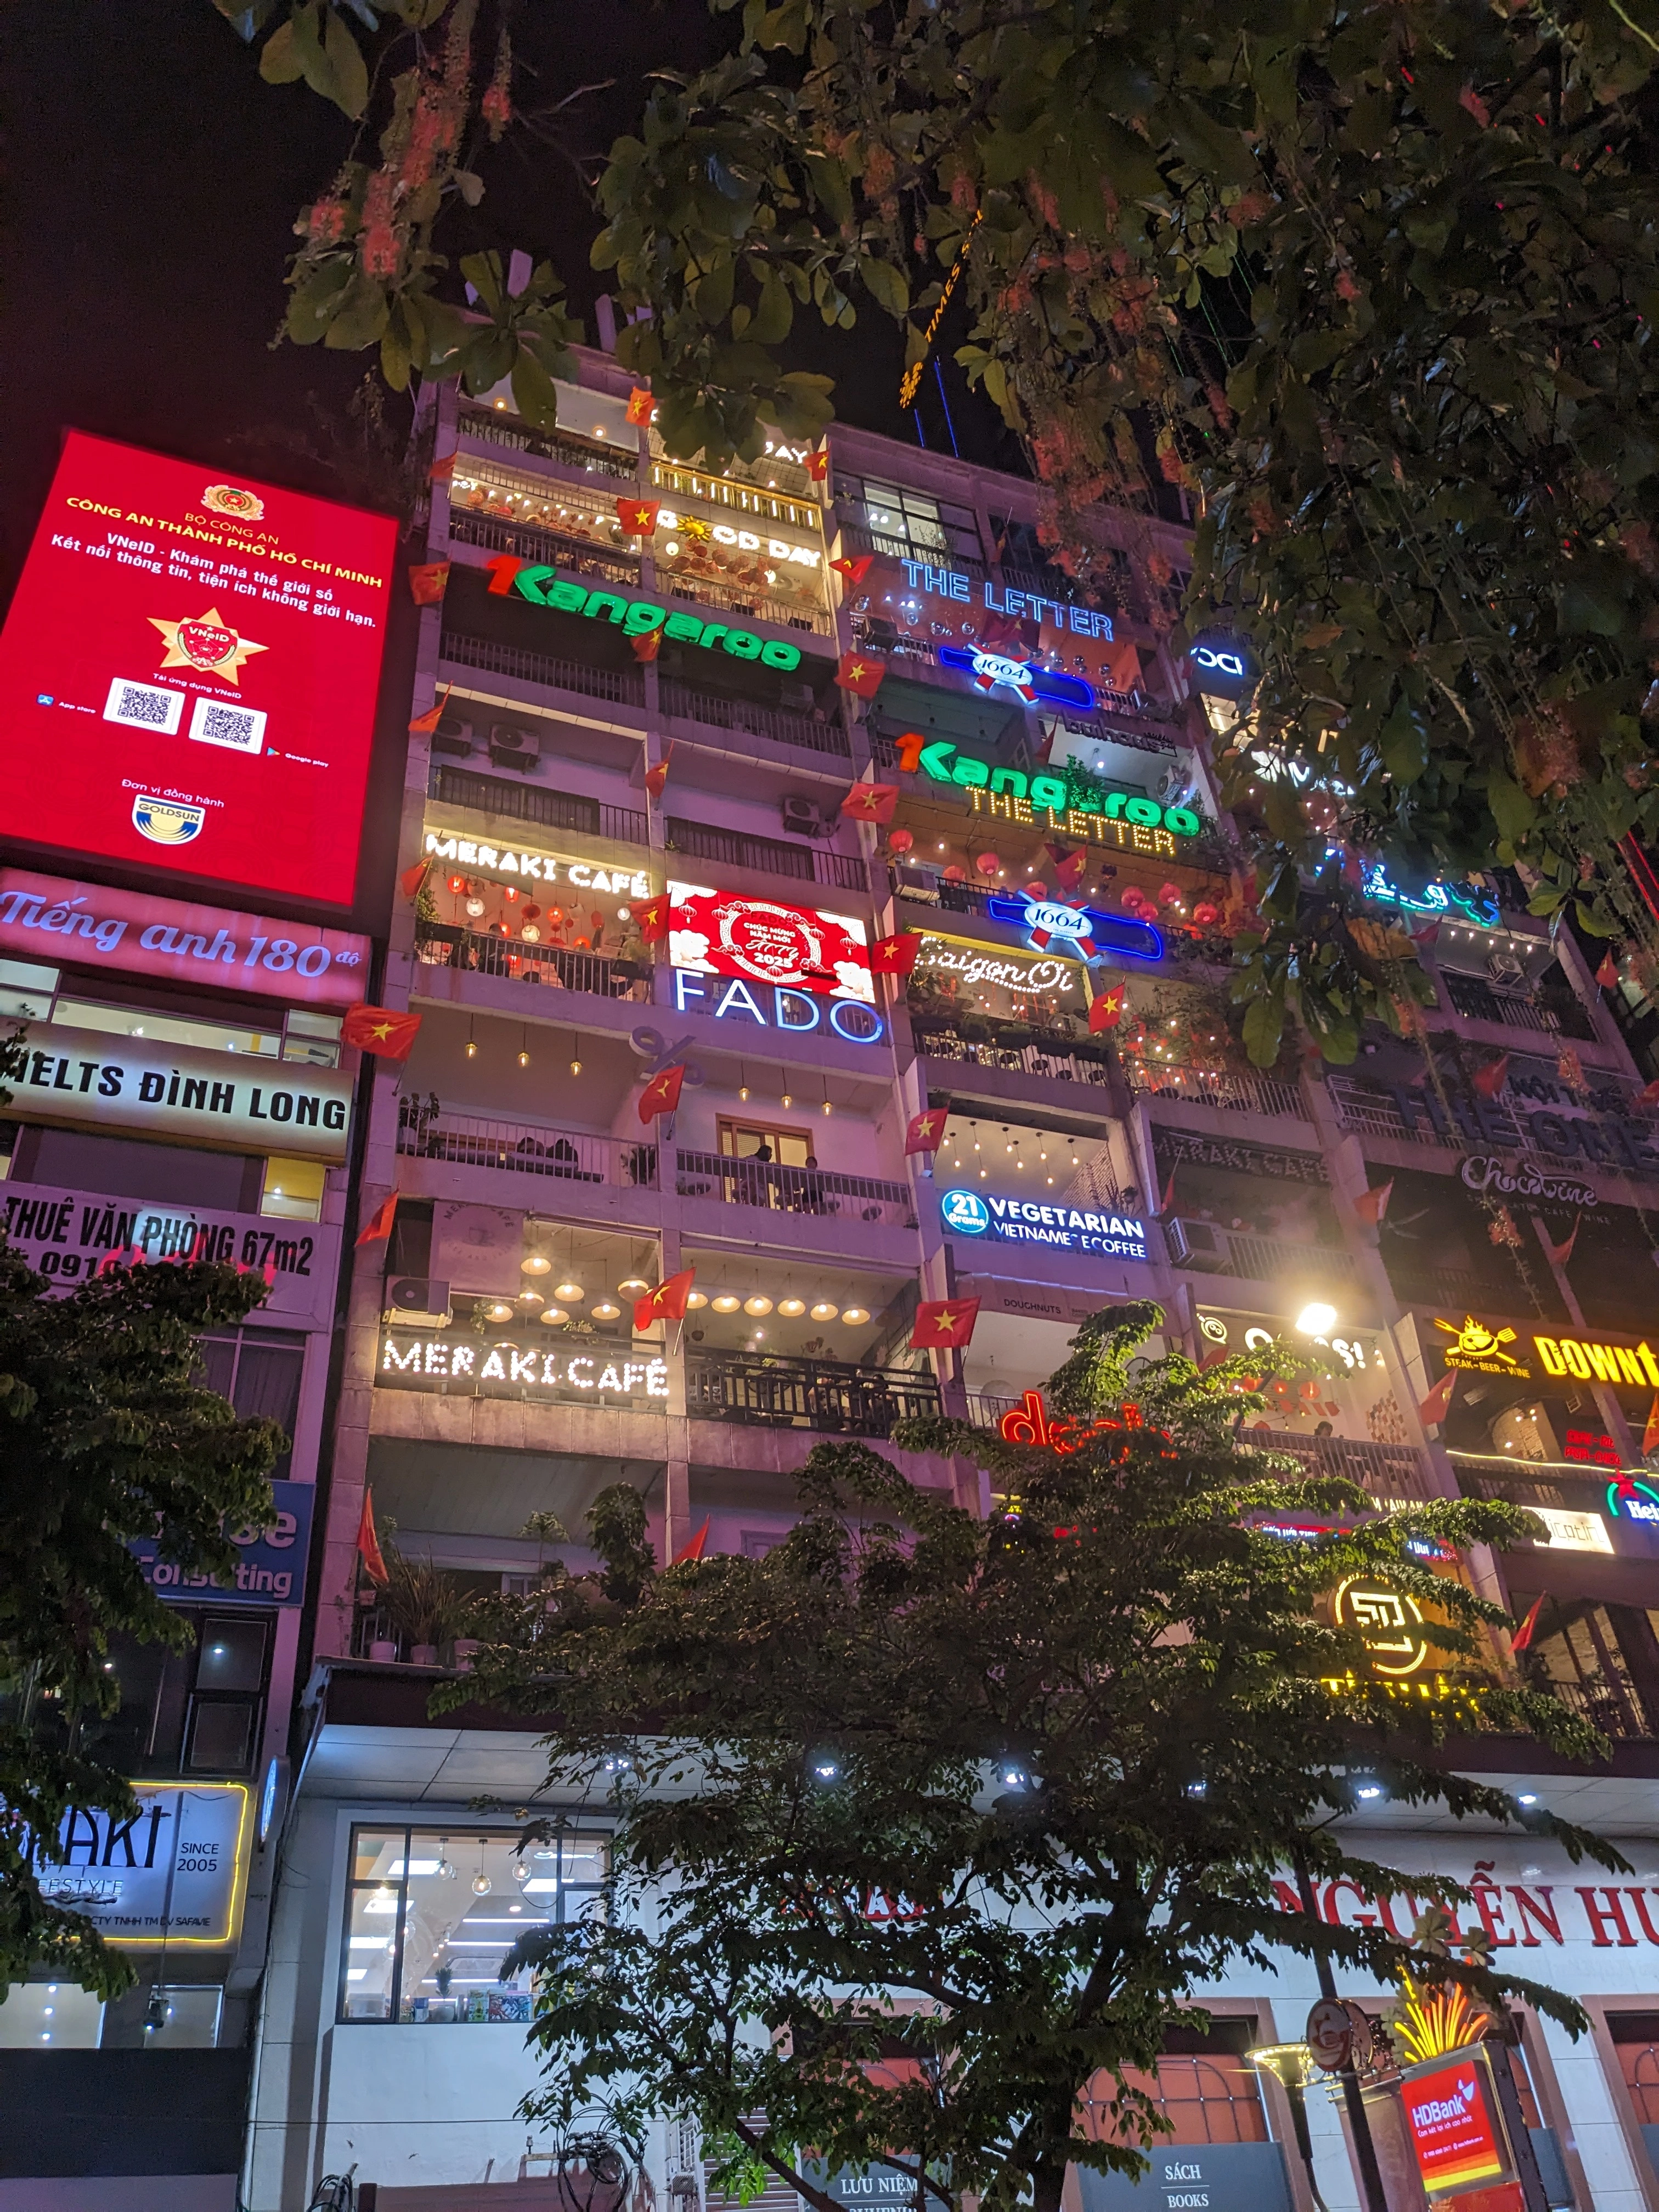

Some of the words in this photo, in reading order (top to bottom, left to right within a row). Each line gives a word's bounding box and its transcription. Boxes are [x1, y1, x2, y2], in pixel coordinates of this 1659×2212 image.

[66, 495, 122, 518] CÔNG
[125, 511, 154, 527] AN
[157, 517, 223, 546] THÀNH
[226, 536, 267, 557] PHỐ
[269, 548, 297, 565] HỒ
[301, 557, 332, 575] CHÍ
[335, 569, 382, 588] MINH
[184, 514, 207, 526] BỘ
[210, 519, 253, 538] CÔNG
[257, 533, 279, 545] AN
[106, 532, 156, 555] VNeID
[170, 549, 214, 571] Khám
[218, 561, 248, 580] phá
[253, 566, 278, 586] thế
[283, 578, 311, 599] giới
[315, 585, 334, 602] số
[769, 540, 821, 568] DAY
[51, 534, 81, 552] Kết
[86, 543, 111, 559] nối
[116, 548, 163, 574] thông
[167, 564, 193, 582] tin,
[199, 569, 228, 590] tiện
[234, 579, 258, 597] ích
[262, 587, 308, 612] không
[313, 600, 341, 619] giới
[345, 610, 376, 629] hạn.
[901, 558, 970, 603] THE
[984, 582, 1114, 642] LETTER
[189, 626, 230, 642] VNeID
[981, 659, 1025, 679] 1664
[153, 673, 167, 681] Tải
[168, 676, 187, 688] ứng
[189, 681, 212, 693] dụng
[215, 687, 241, 699] VNeID
[59, 702, 76, 711] App
[77, 706, 95, 714] store
[285, 752, 312, 765] Google
[313, 759, 329, 768] play
[121, 778, 148, 791] Đơn
[151, 785, 161, 797] vị
[163, 787, 193, 803] đồng
[195, 794, 225, 809] hành
[895, 732, 1201, 837] Kangroo
[138, 803, 200, 823] GOLDSUN
[965, 785, 1034, 824] THE
[1048, 805, 1176, 855] LETTER
[426, 834, 556, 881] MERAKI
[1035, 909, 1083, 930] 1664
[0, 891, 128, 952] Tiếng
[140, 924, 236, 964] anh
[244, 936, 331, 978] 180
[336, 951, 363, 967] độ
[754, 952, 793, 968] 2025
[675, 968, 884, 1043] FADO
[139, 1069, 235, 1115] ĐÌNH
[249, 1088, 346, 1131] LONG
[952, 1194, 979, 1217] 21
[989, 1197, 1144, 1239] VEGETARIAN
[949, 1212, 986, 1227] Grams
[5, 1196, 75, 1244] THUÊ
[80, 1204, 137, 1252] VĂN
[143, 1213, 234, 1263] PHÒNG
[243, 1230, 314, 1277] 67m2
[1003, 1298, 1062, 1314] DOUGHNUTS
[383, 1340, 555, 1384] MERAKI
[1444, 1357, 1474, 1369] STEAK
[1480, 1363, 1500, 1373] BEER
[1508, 1367, 1531, 1379] WINE
[180, 1842, 220, 1855] SINCE
[176, 1858, 218, 1872] 2005
[1412, 2094, 1466, 2128] HDBank
[840, 2176, 872, 2194] LƯU
[878, 2173, 918, 2196] NIỆM
[1165, 2162, 1201, 2181] SÁCH
[1167, 2193, 1209, 2210] BOOKS
